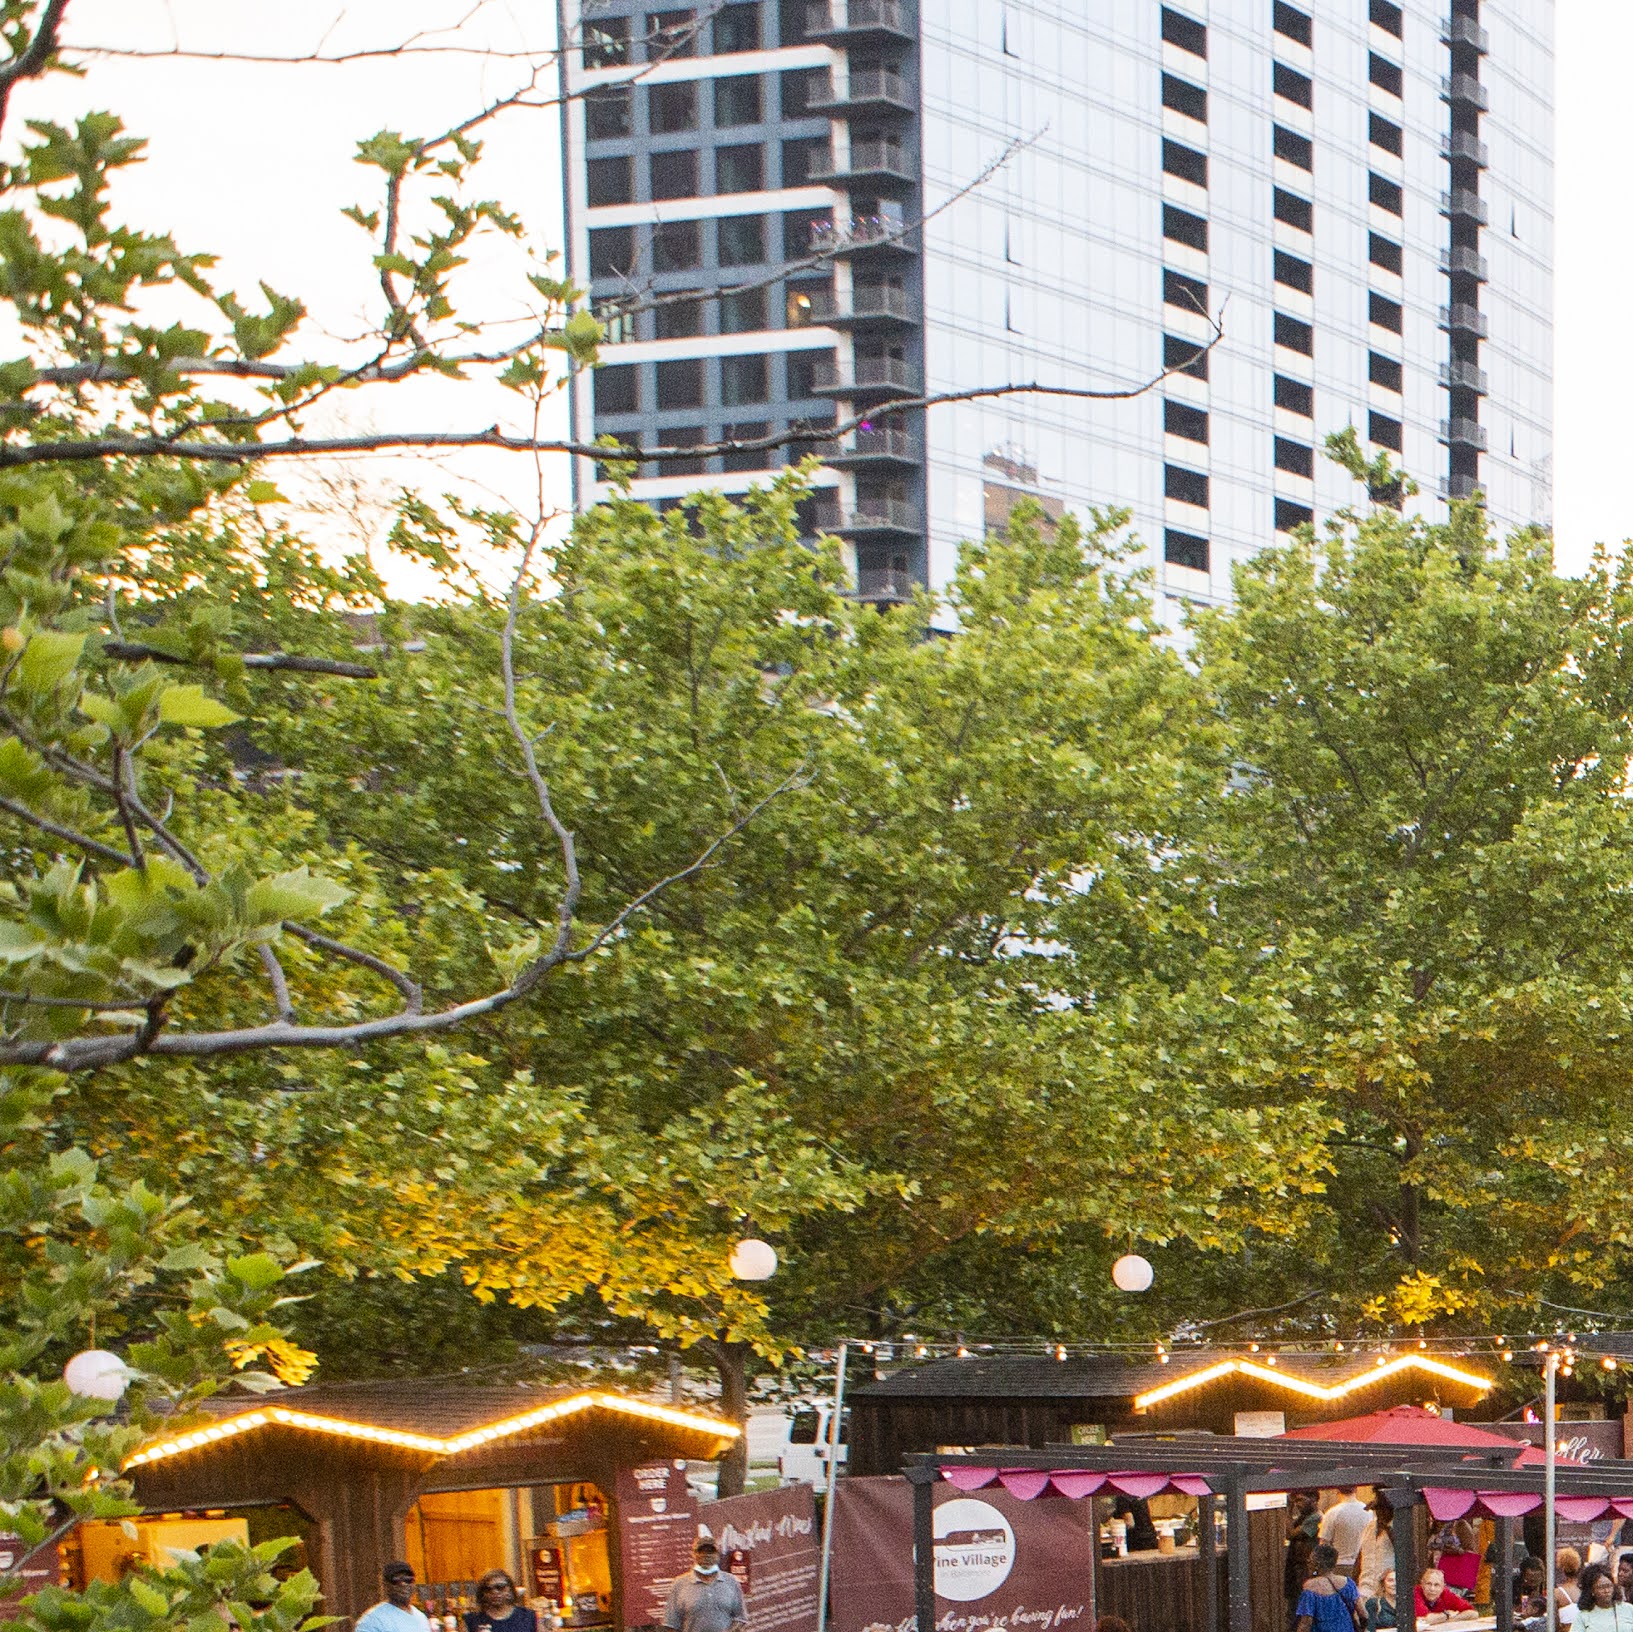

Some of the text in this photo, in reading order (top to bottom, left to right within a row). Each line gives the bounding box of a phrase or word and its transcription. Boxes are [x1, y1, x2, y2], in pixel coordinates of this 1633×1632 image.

[936, 1553, 1007, 1568] ine Village
[1010, 1605, 1054, 1630] having
[1054, 1604, 1084, 1627] fun!
